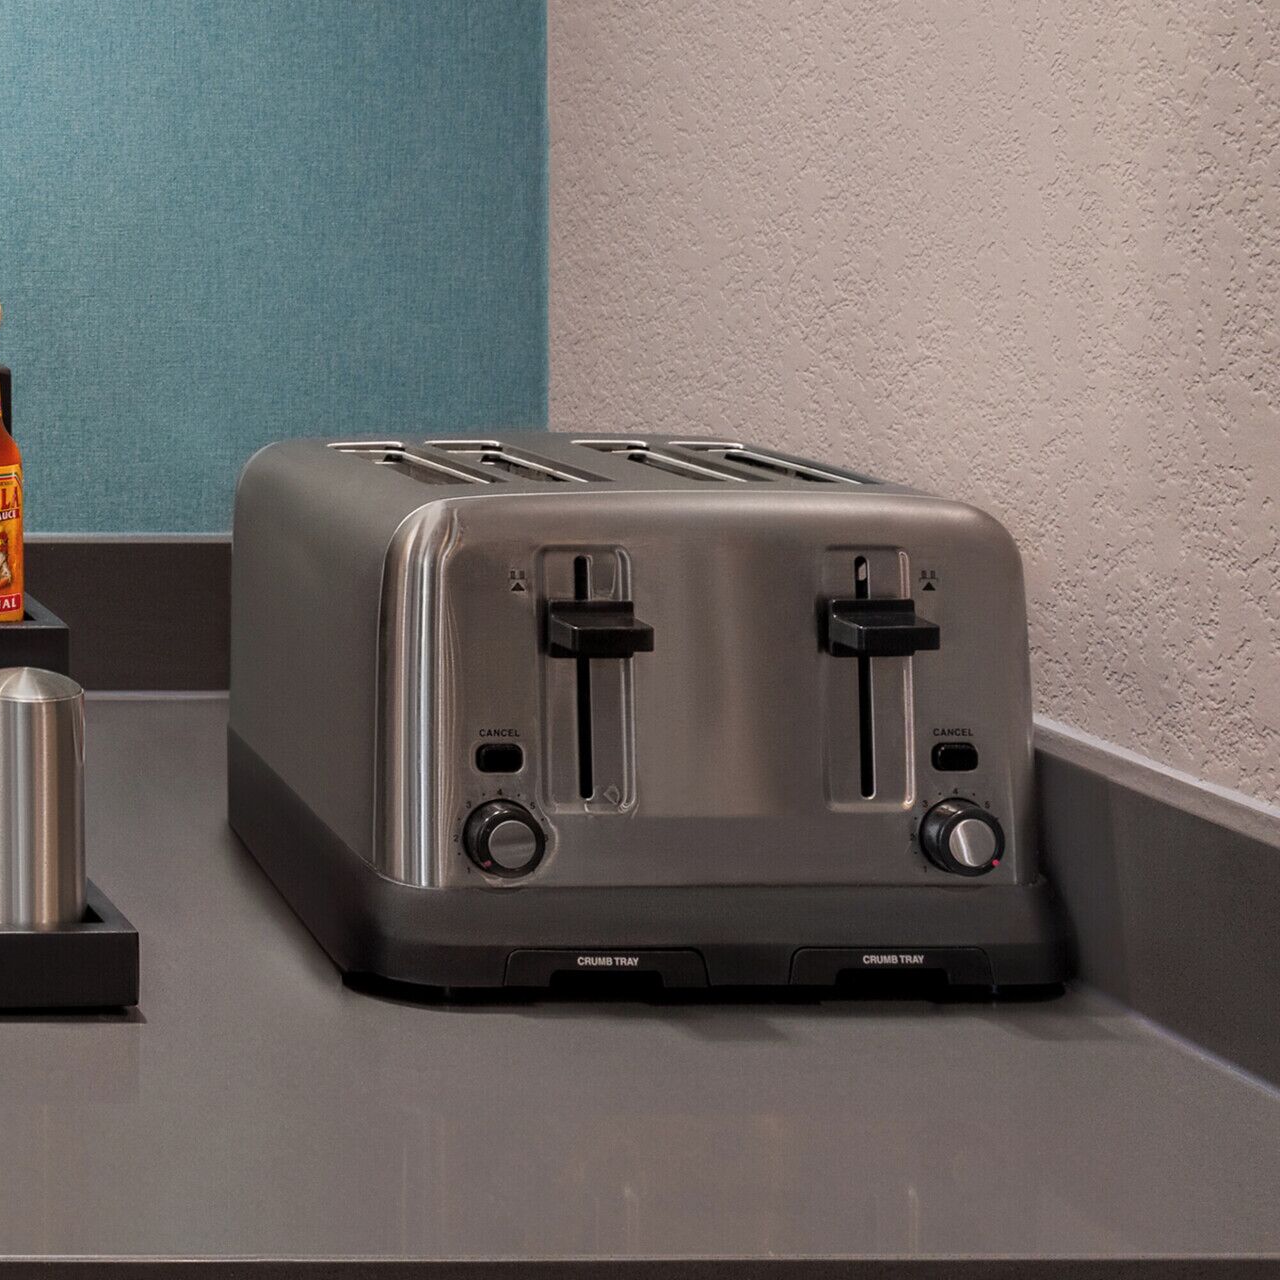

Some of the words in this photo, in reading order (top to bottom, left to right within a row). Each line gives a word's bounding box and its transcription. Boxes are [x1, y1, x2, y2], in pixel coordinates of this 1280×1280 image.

[479, 729, 520, 738] CANCEL
[933, 728, 974, 737] CANCEL
[577, 956, 613, 966] CRUMB
[614, 956, 639, 966] TRAY
[862, 955, 898, 964] CRUMB
[899, 955, 924, 964] TRAY
